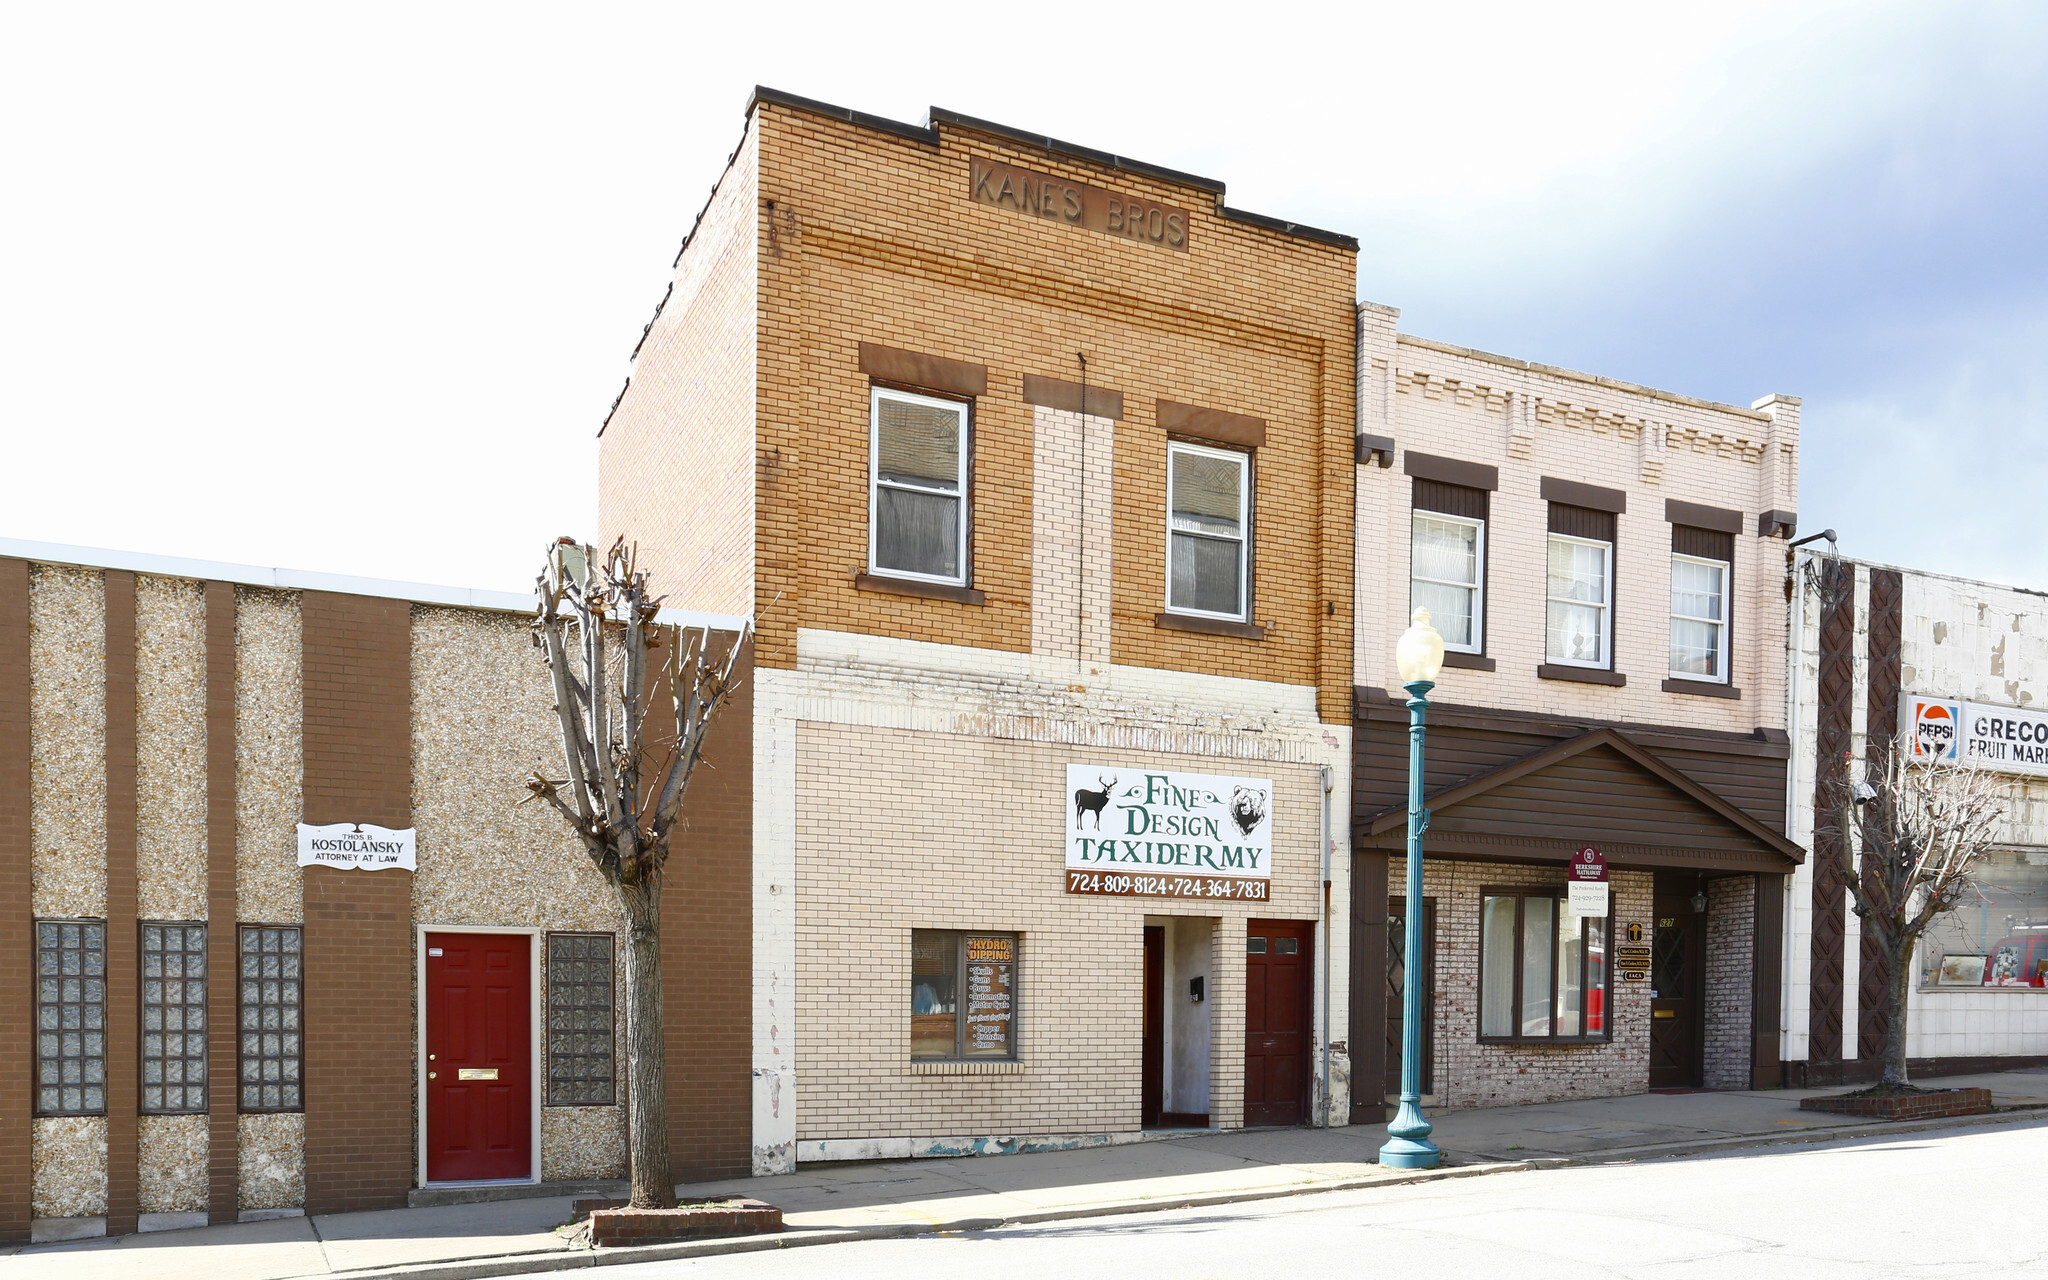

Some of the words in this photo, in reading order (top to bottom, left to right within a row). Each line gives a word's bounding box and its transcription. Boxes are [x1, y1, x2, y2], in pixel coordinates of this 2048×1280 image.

[974, 163, 1081, 221] KANE'S
[1107, 198, 1185, 247] BROS
[1918, 722, 1953, 739] PEPSI
[1974, 716, 2048, 744] GRECO
[1969, 738, 2007, 759] FRUIT
[1143, 774, 1208, 812] FINE
[1116, 804, 1223, 842] DESIGN
[311, 839, 404, 853] KOSTOLANSKY
[315, 853, 359, 862] ATTORNEY
[362, 854, 373, 862] AT
[378, 855, 398, 863] LAW
[1075, 837, 1263, 871] TAXIDERMY
[1070, 873, 1166, 895] 724-809-8124
[1174, 878, 1266, 898] 724-364-7831
[973, 940, 1007, 950] HYDRO
[970, 950, 1010, 960] DIPPING
[973, 966, 993, 975] Skulls
[973, 975, 990, 984] Guns
[973, 983, 991, 992] Bows
[973, 992, 1010, 1001] Automotive
[977, 1024, 1000, 1034] Copper
[976, 1032, 1005, 1042] Bronzing
